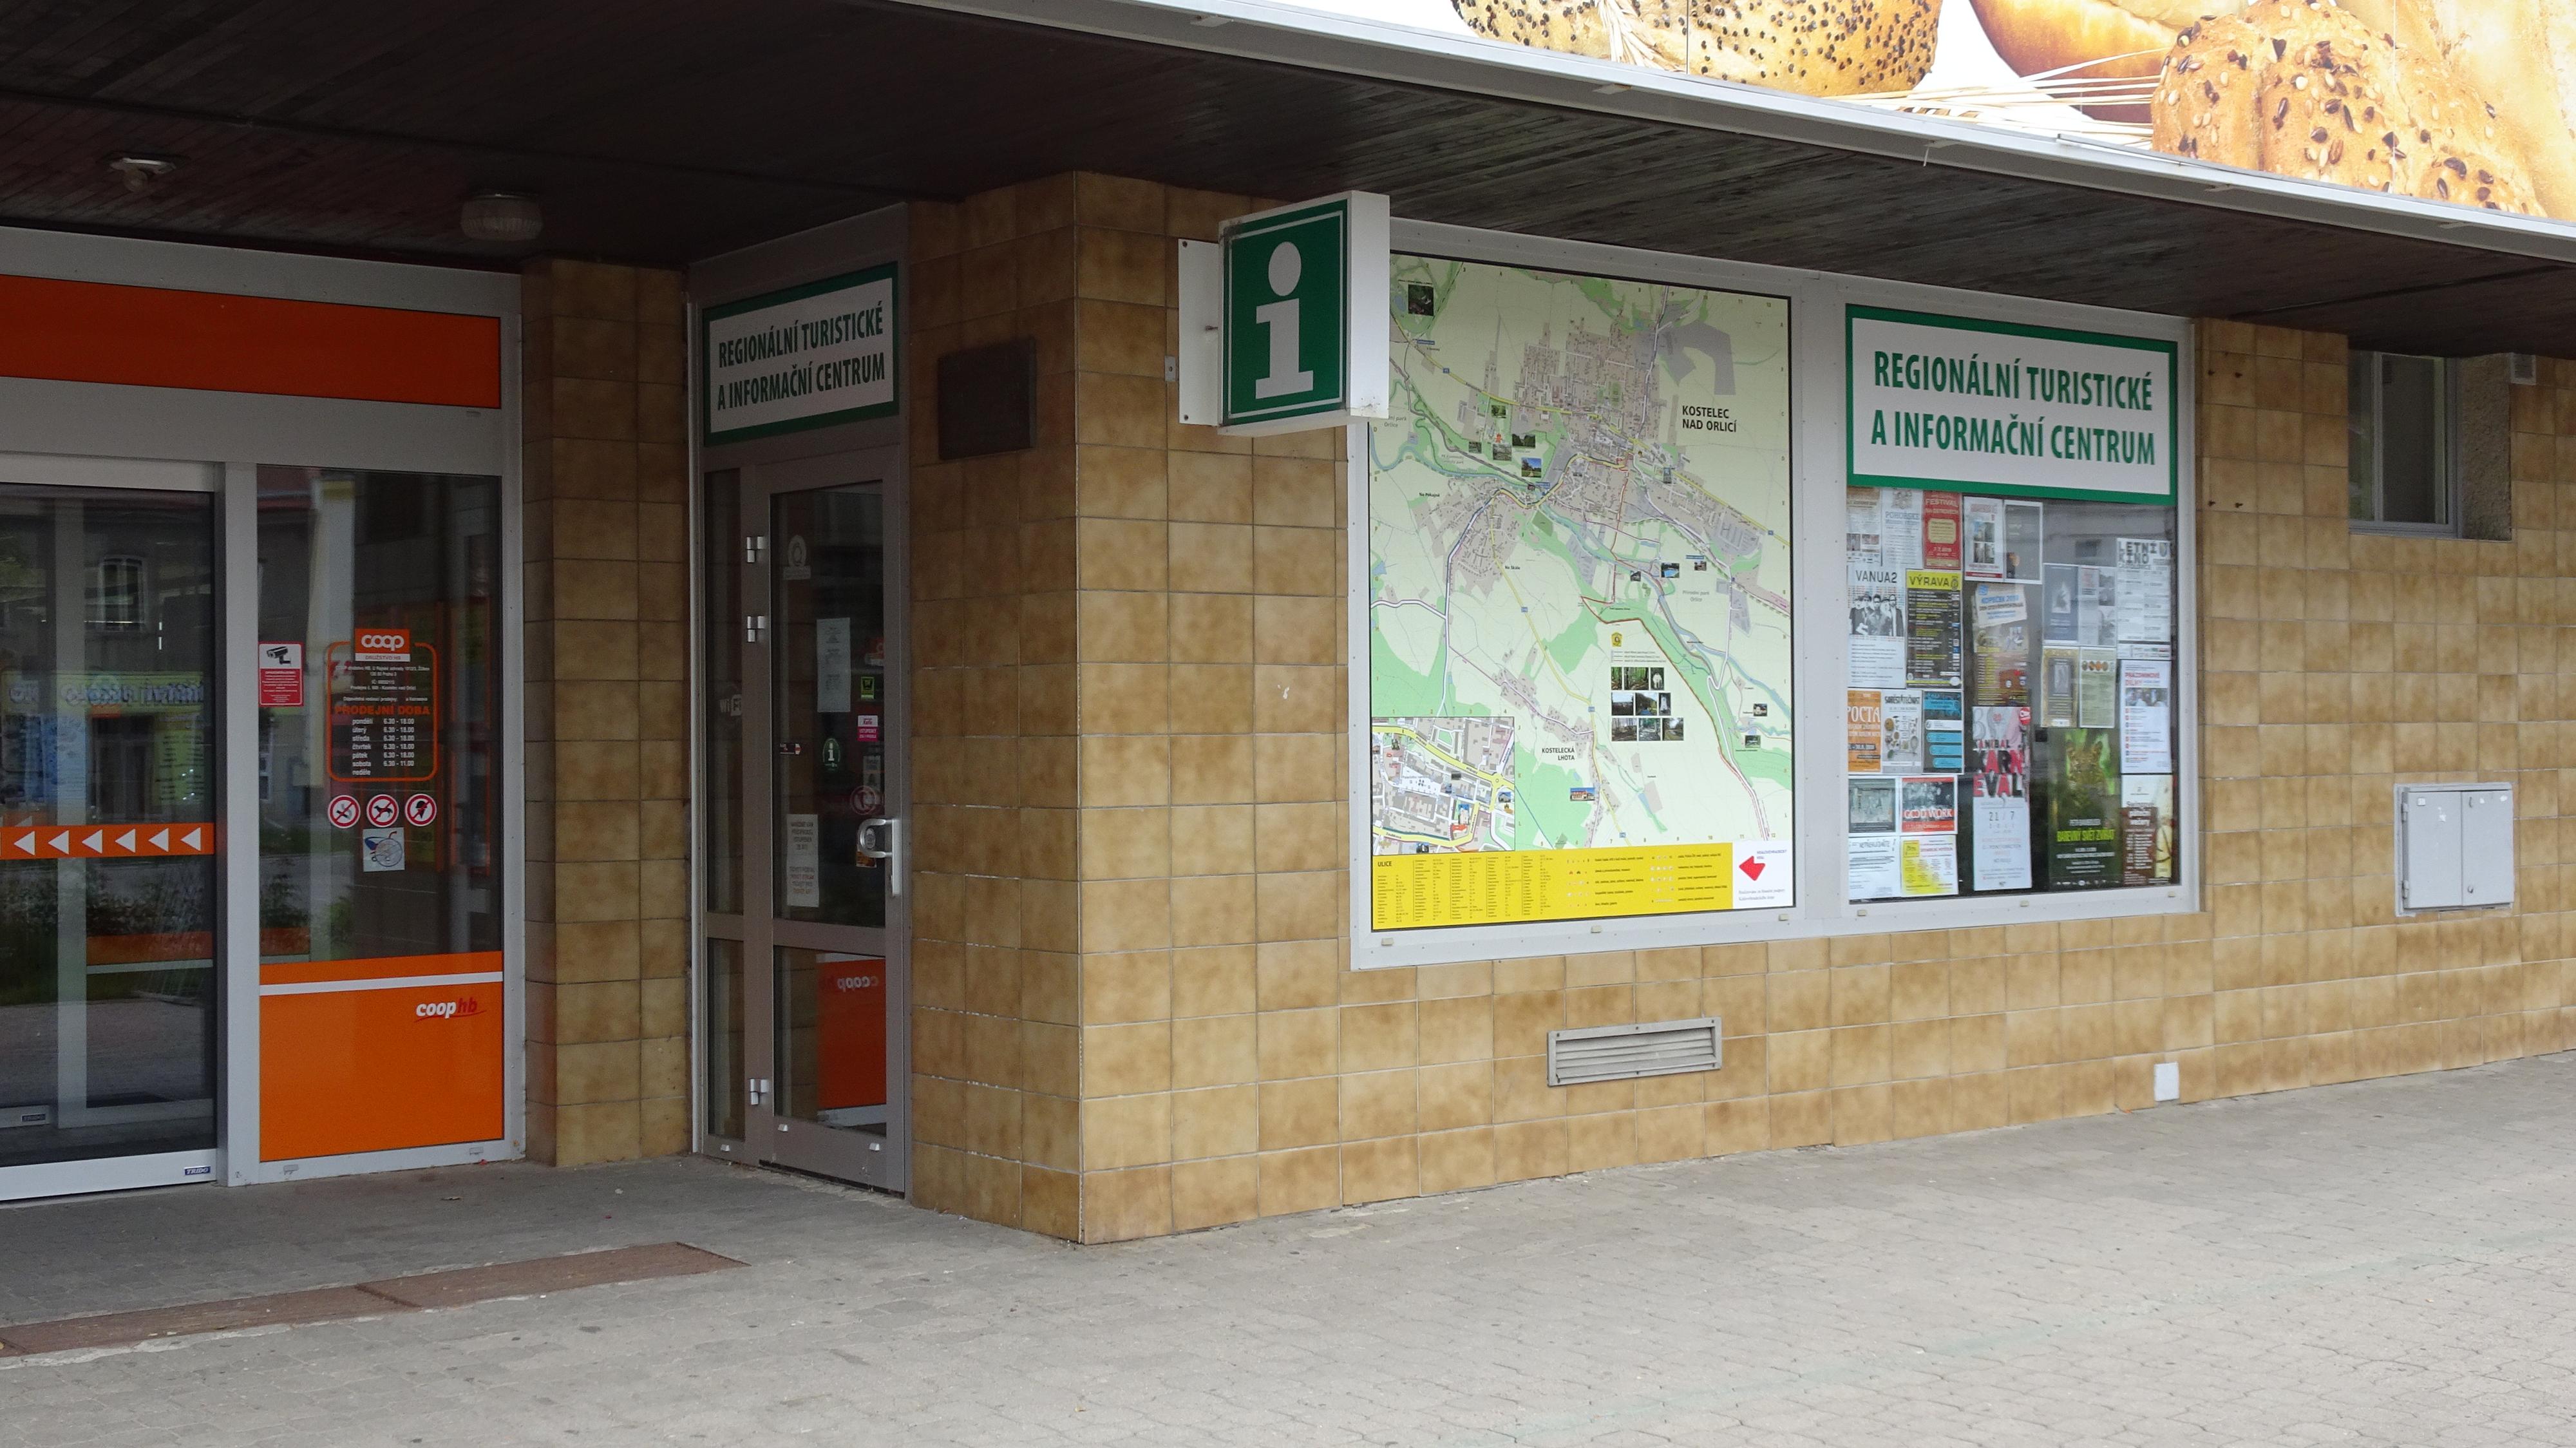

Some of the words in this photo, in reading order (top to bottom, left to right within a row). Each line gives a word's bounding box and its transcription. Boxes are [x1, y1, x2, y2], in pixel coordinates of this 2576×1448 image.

[719, 319, 799, 368] REGIONÁLNÍ
[802, 300, 884, 350] TURISTICKÉ
[718, 385, 726, 411] A
[729, 361, 813, 408] INFORMAČNÍ
[816, 352, 885, 393] CENTRUM
[1874, 350, 2022, 399] REGIONÁLNÍ
[2026, 367, 2152, 411] TURISTICKÉ
[1682, 405, 1730, 419] KOSTELEC
[1682, 419, 1703, 430] NAD
[1707, 419, 1738, 432] ORLICÍ
[1871, 410, 1888, 446] A
[1894, 412, 2045, 458] INFORMAČNÍ
[2050, 424, 2155, 466] CENTRUM
[2118, 540, 2157, 555] LETNÍ
[2118, 553, 2150, 564] KINO
[1855, 569, 1898, 584] VANUA2
[1908, 574, 1950, 587] VÝRAVA
[361, 634, 405, 652] coop
[334, 704, 395, 716] PRODEJNÍ
[398, 705, 431, 716] DOBA
[1989, 812, 2000, 821] 21
[2010, 811, 2015, 820] 7
[415, 1002, 457, 1019] coop
